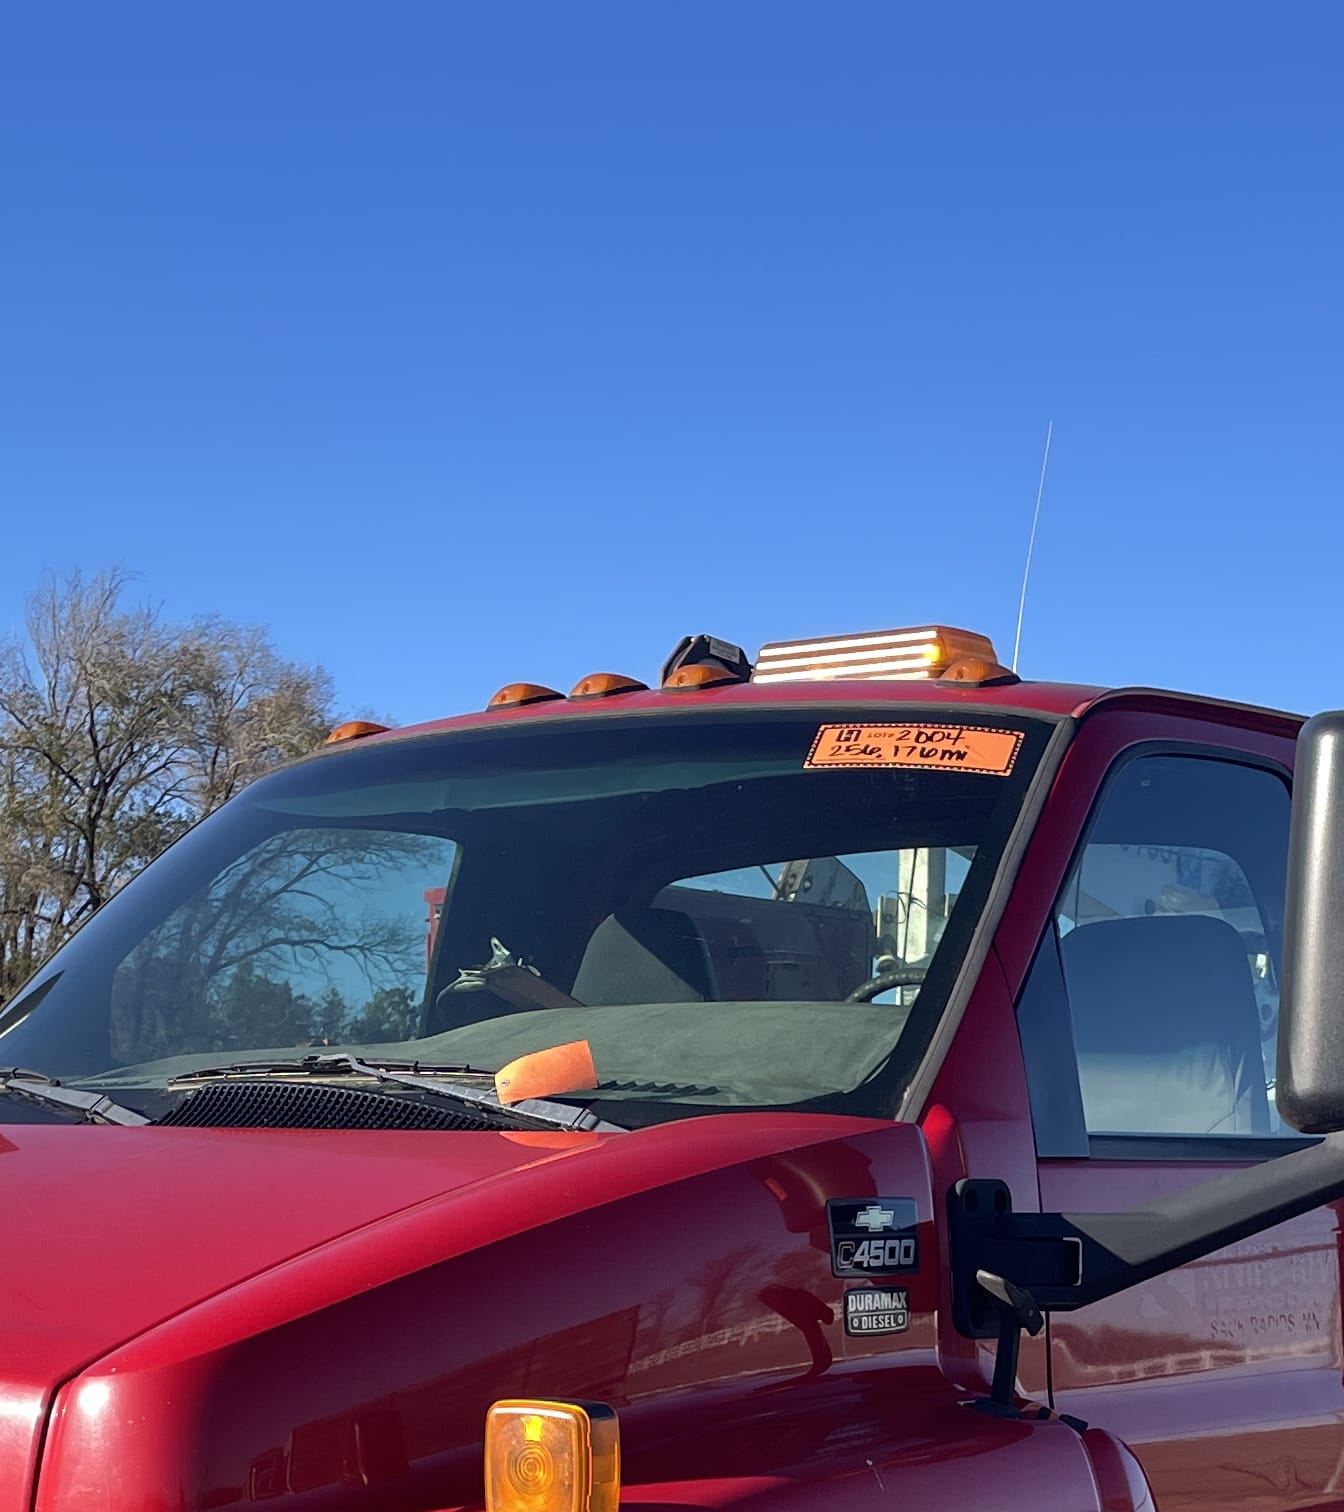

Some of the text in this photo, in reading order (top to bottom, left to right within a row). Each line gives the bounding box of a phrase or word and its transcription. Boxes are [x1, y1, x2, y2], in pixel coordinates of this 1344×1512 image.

[837, 1239, 916, 1268] C4500
[848, 1292, 907, 1312] DURAMAX
[861, 1315, 897, 1329] DIESEL
